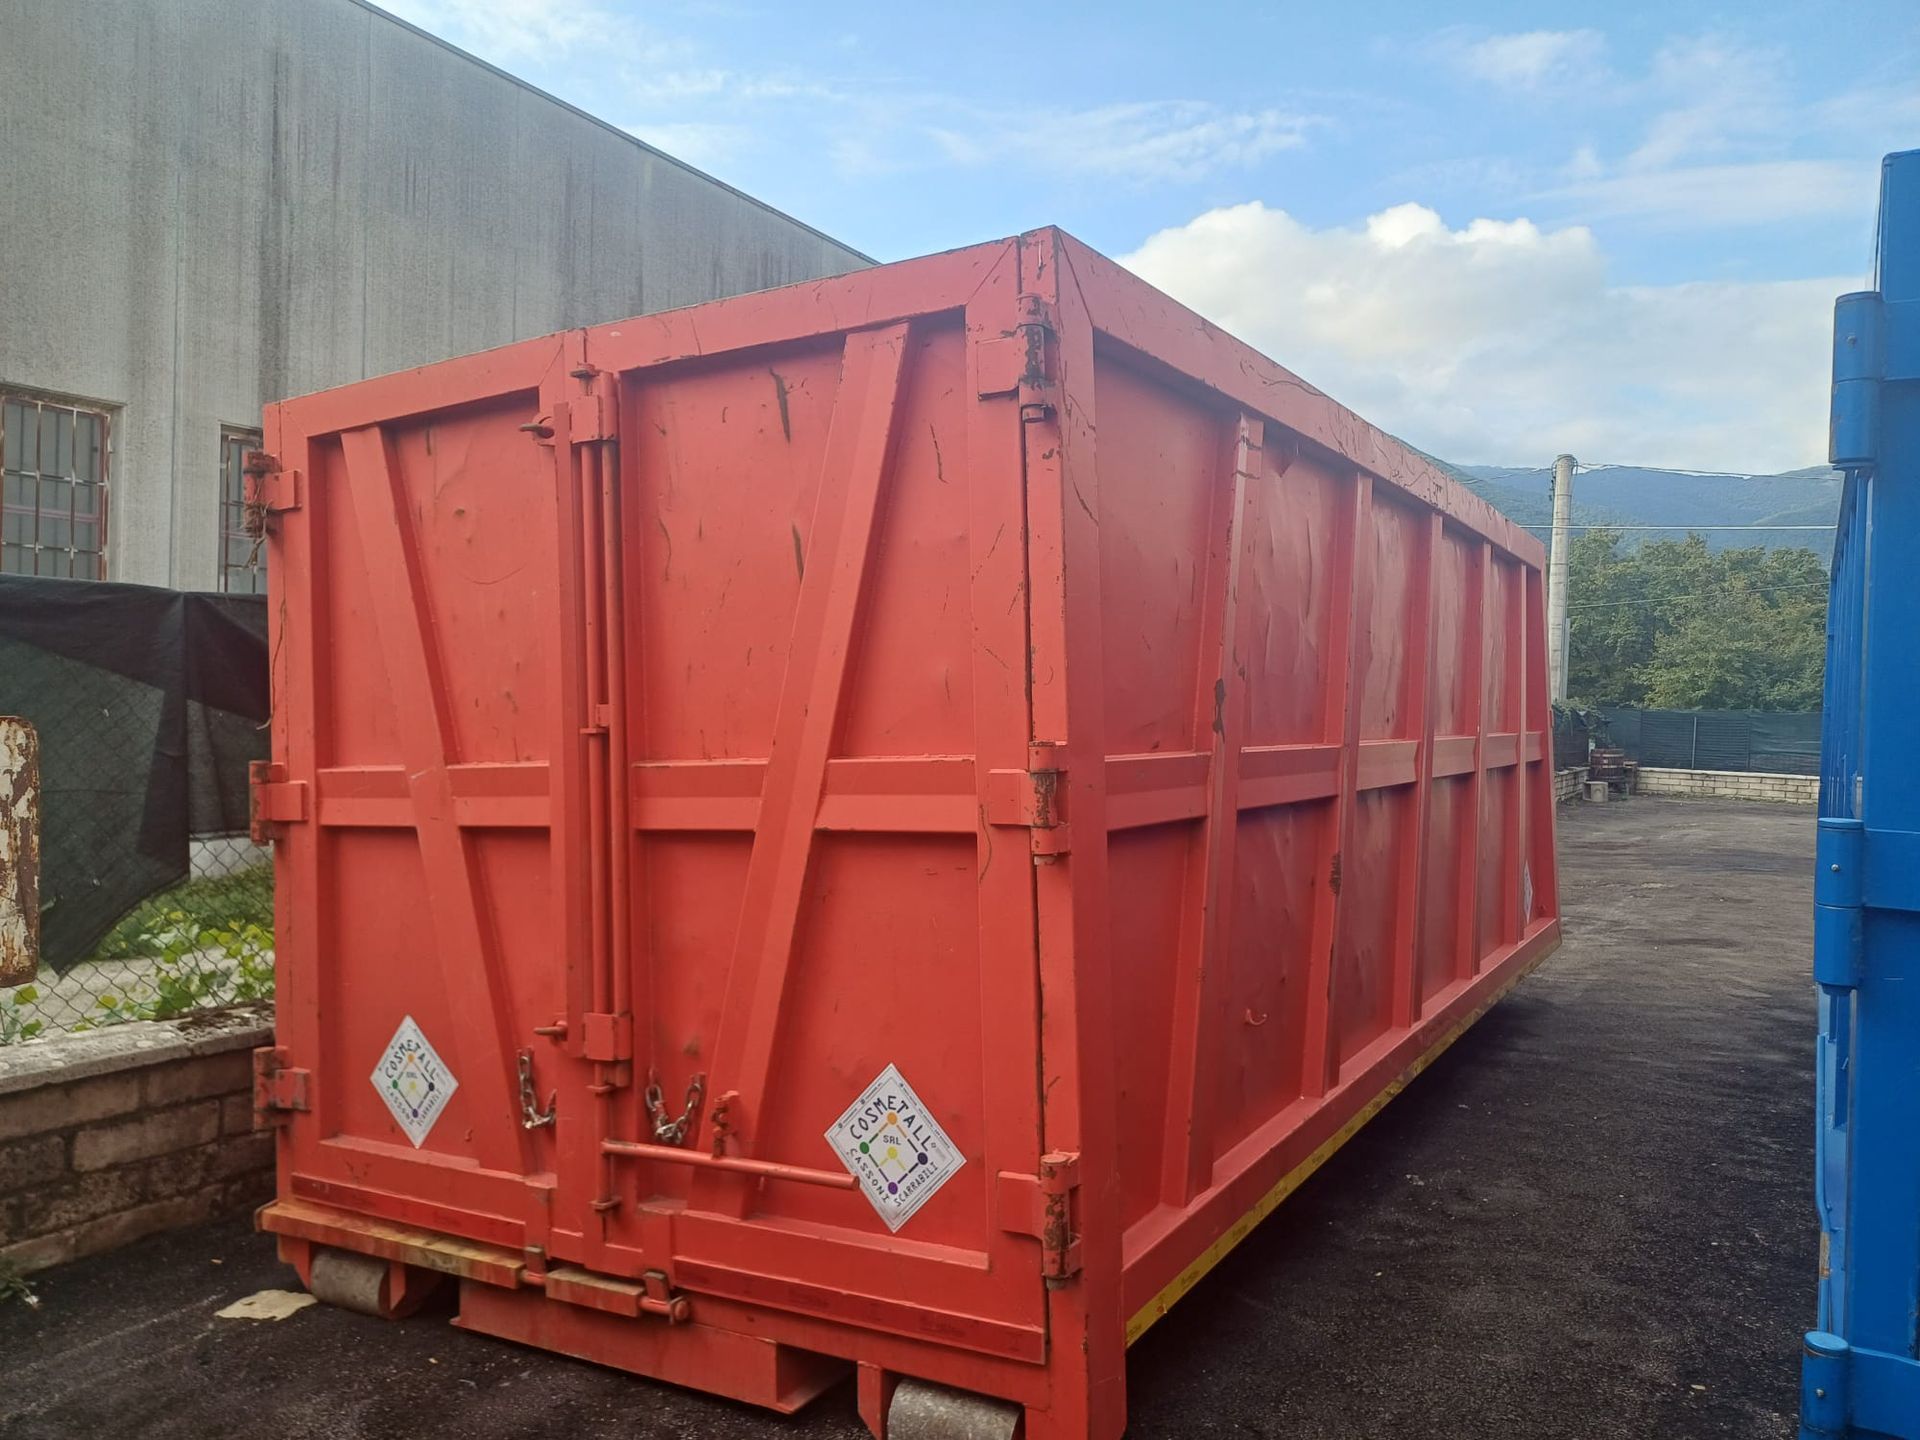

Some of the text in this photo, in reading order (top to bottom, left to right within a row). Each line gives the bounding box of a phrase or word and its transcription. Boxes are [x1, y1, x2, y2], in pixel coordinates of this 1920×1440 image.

[385, 1039, 438, 1081] COSMETALL
[850, 1095, 931, 1152] COSMETALL
[883, 1135, 901, 1145] SRL
[849, 1148, 890, 1203] CASSONI
[893, 1162, 938, 1207] SCARRABILI
